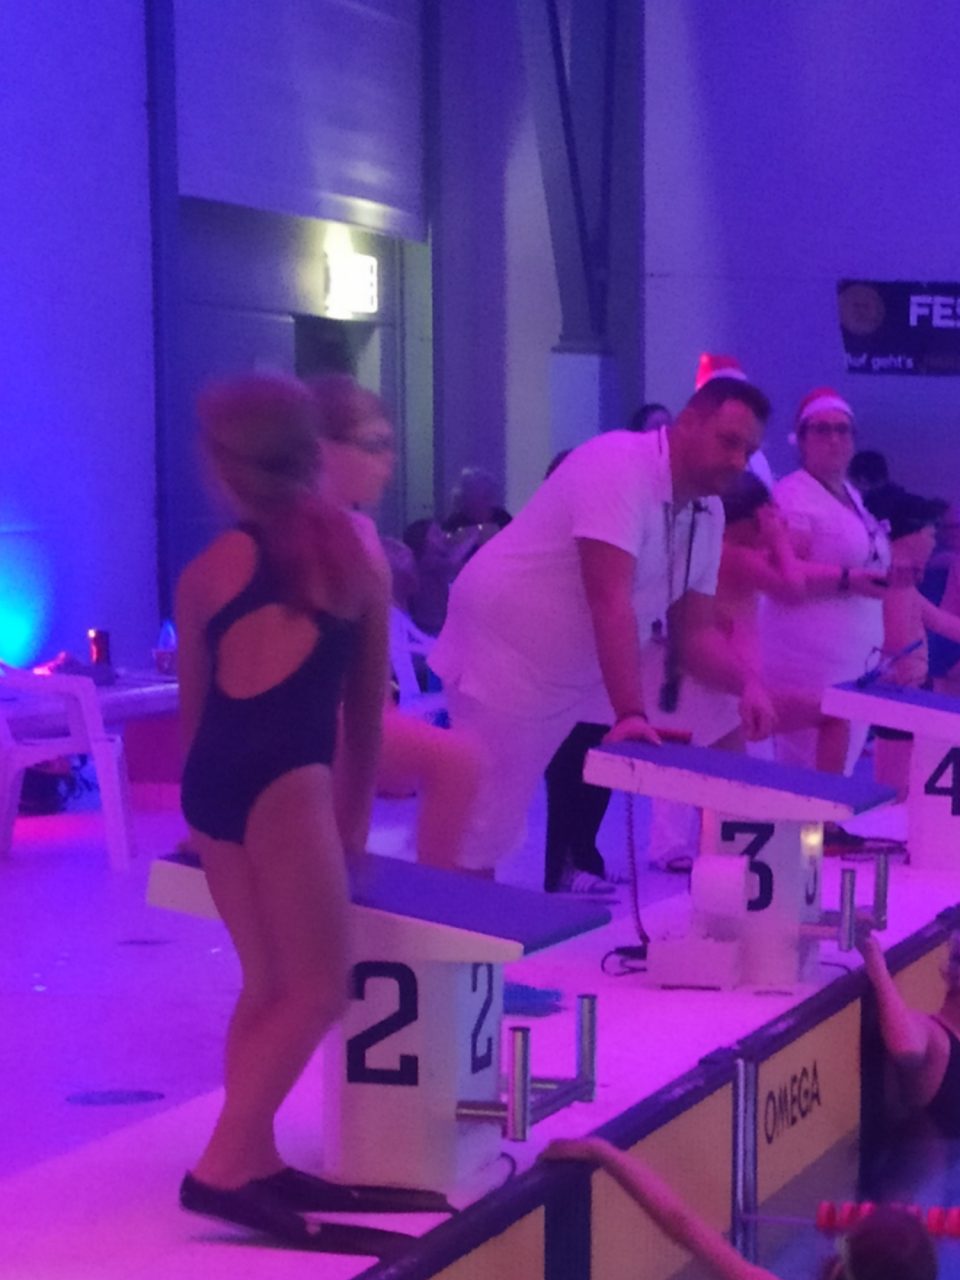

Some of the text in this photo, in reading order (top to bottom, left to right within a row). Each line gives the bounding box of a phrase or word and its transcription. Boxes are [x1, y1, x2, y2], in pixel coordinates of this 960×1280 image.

[720, 820, 775, 912] 3
[346, 960, 418, 1087] 2
[471, 962, 494, 1075] 2
[763, 1058, 821, 1145] OMEGA
